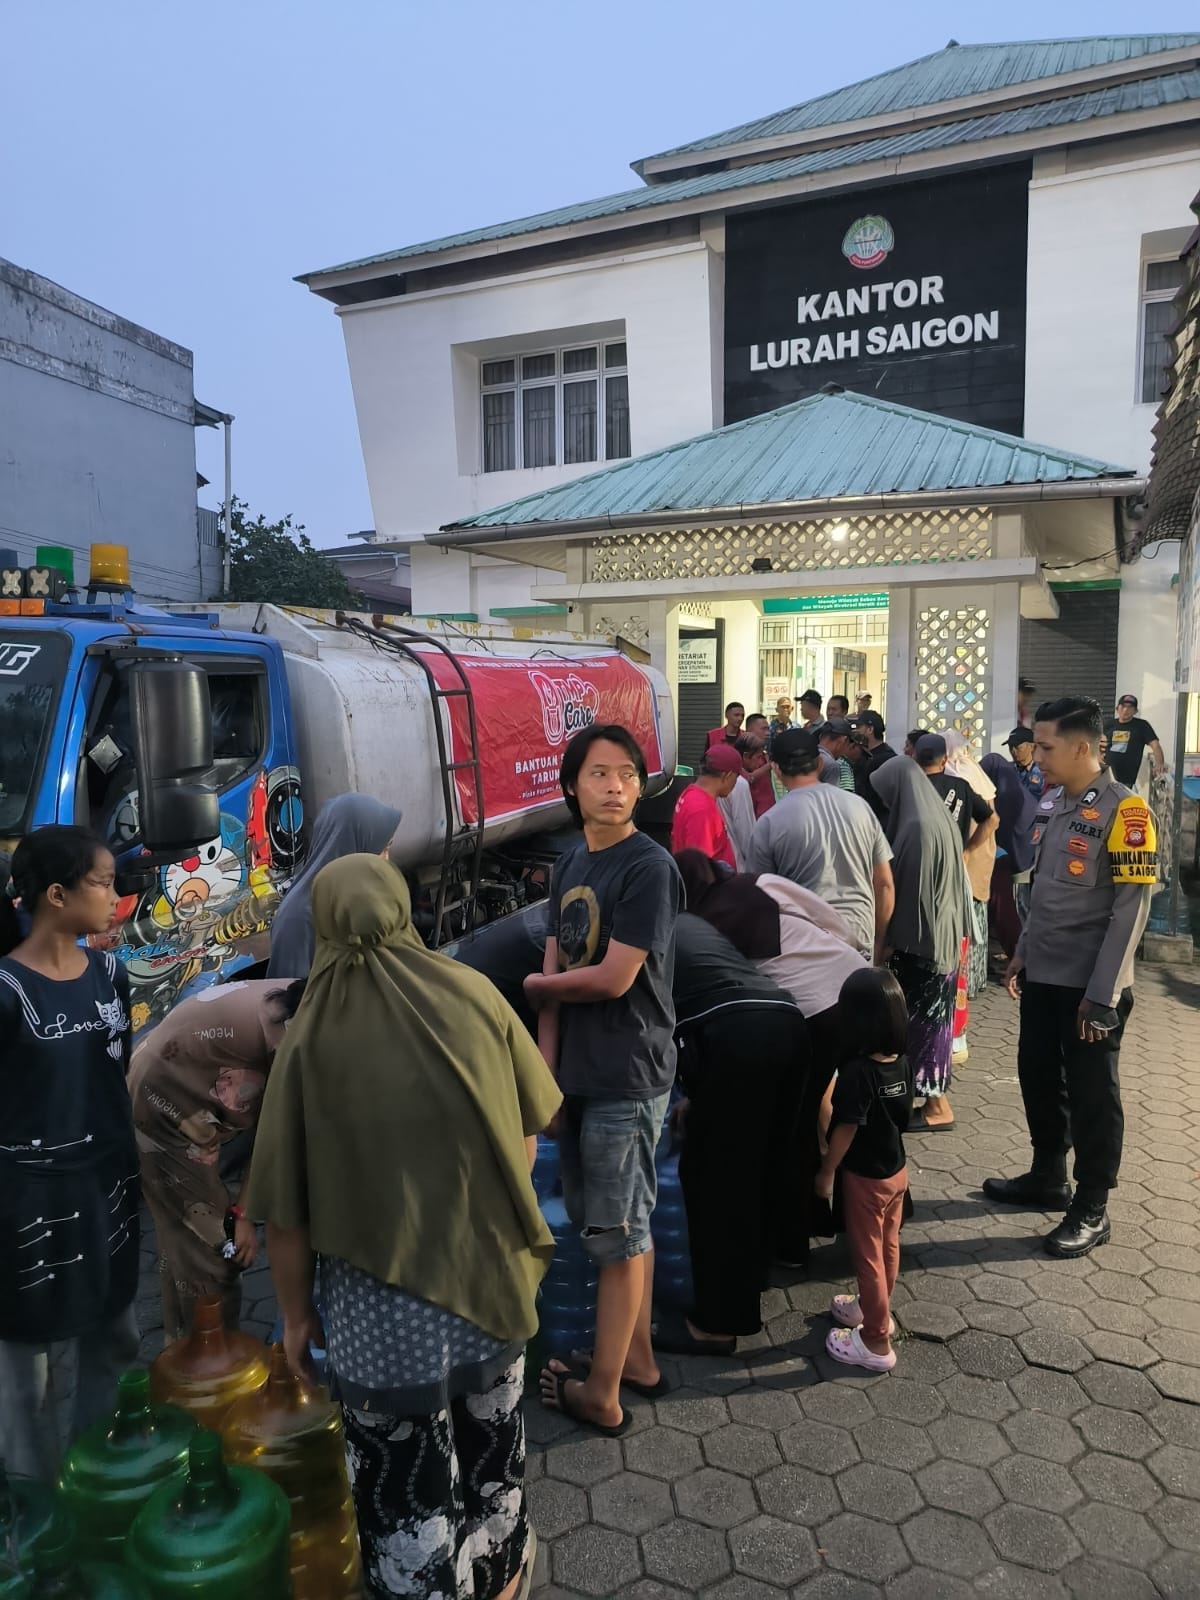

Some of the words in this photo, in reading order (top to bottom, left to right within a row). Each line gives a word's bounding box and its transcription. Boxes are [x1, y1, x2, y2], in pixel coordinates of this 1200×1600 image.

[797, 275, 944, 323] KANTOR
[750, 329, 860, 371] LURAH
[866, 310, 999, 355] SAIGON
[564, 701, 594, 731] Care
[515, 755, 558, 774] BANTUAN
[532, 769, 560, 786] TARUN
[1069, 820, 1105, 839] POLRI
[1128, 866, 1156, 877] SAIGO
[44, 1013, 107, 1039] Love
